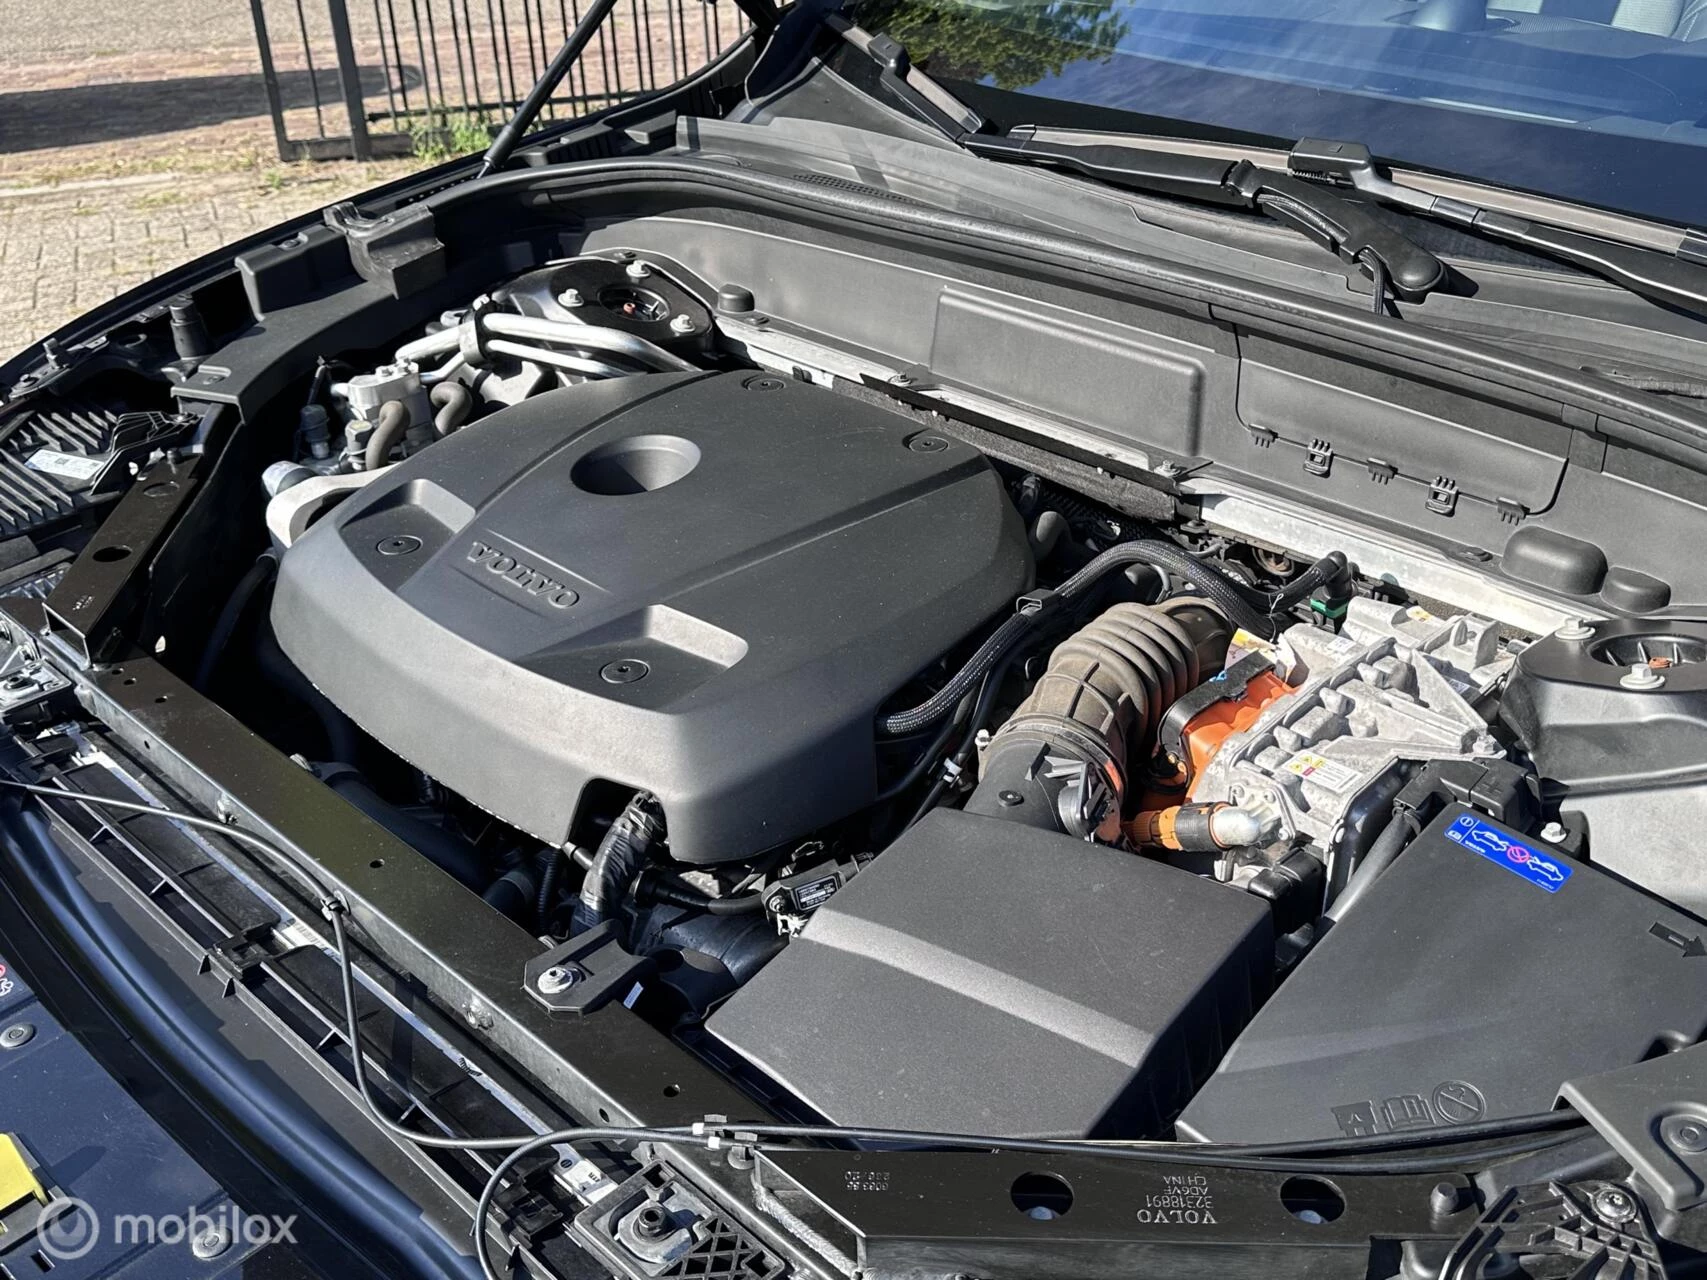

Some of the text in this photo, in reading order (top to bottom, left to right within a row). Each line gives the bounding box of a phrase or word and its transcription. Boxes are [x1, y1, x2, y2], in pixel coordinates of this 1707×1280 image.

[467, 540, 580, 609] VOLVO
[1163, 1175, 1207, 1186] CHINA
[1145, 1194, 1214, 1209] 32318891
[1136, 1209, 1218, 1225] VOLVO
